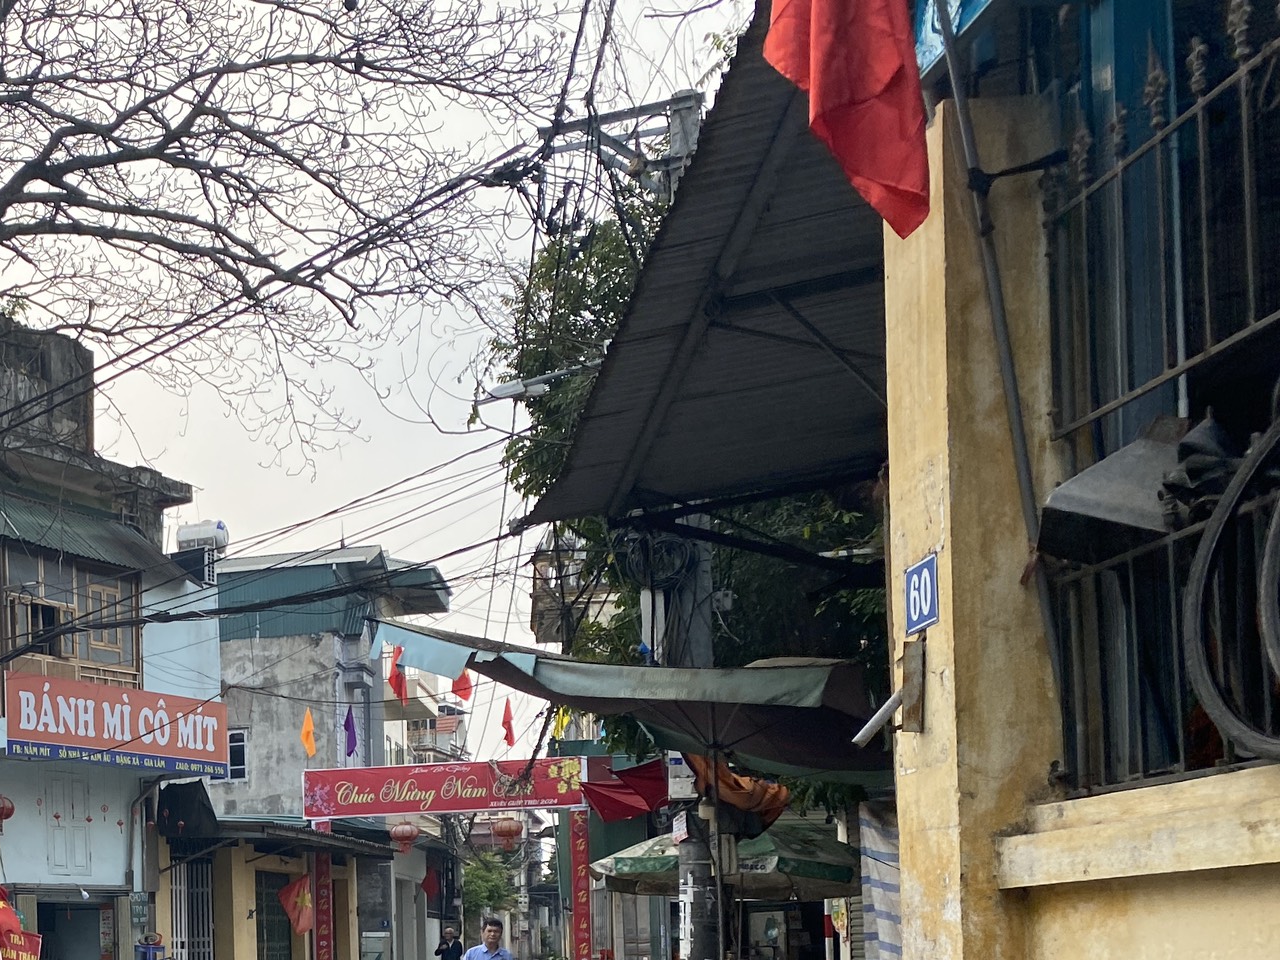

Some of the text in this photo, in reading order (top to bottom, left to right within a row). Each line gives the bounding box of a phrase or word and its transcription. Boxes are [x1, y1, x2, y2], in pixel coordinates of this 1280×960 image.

[909, 567, 931, 622] 60
[19, 682, 218, 752] BÁNH MÌ CÔ MÍT
[12, 744, 23, 754] FB:
[39, 745, 50, 757] MÍT
[144, 758, 154, 767] GIA
[175, 761, 190, 771] ZALO:
[190, 763, 203, 772] 0971
[204, 765, 214, 773] 268
[334, 781, 376, 806] Chúc
[380, 778, 437, 811] Mừng
[440, 775, 488, 800] Năm
